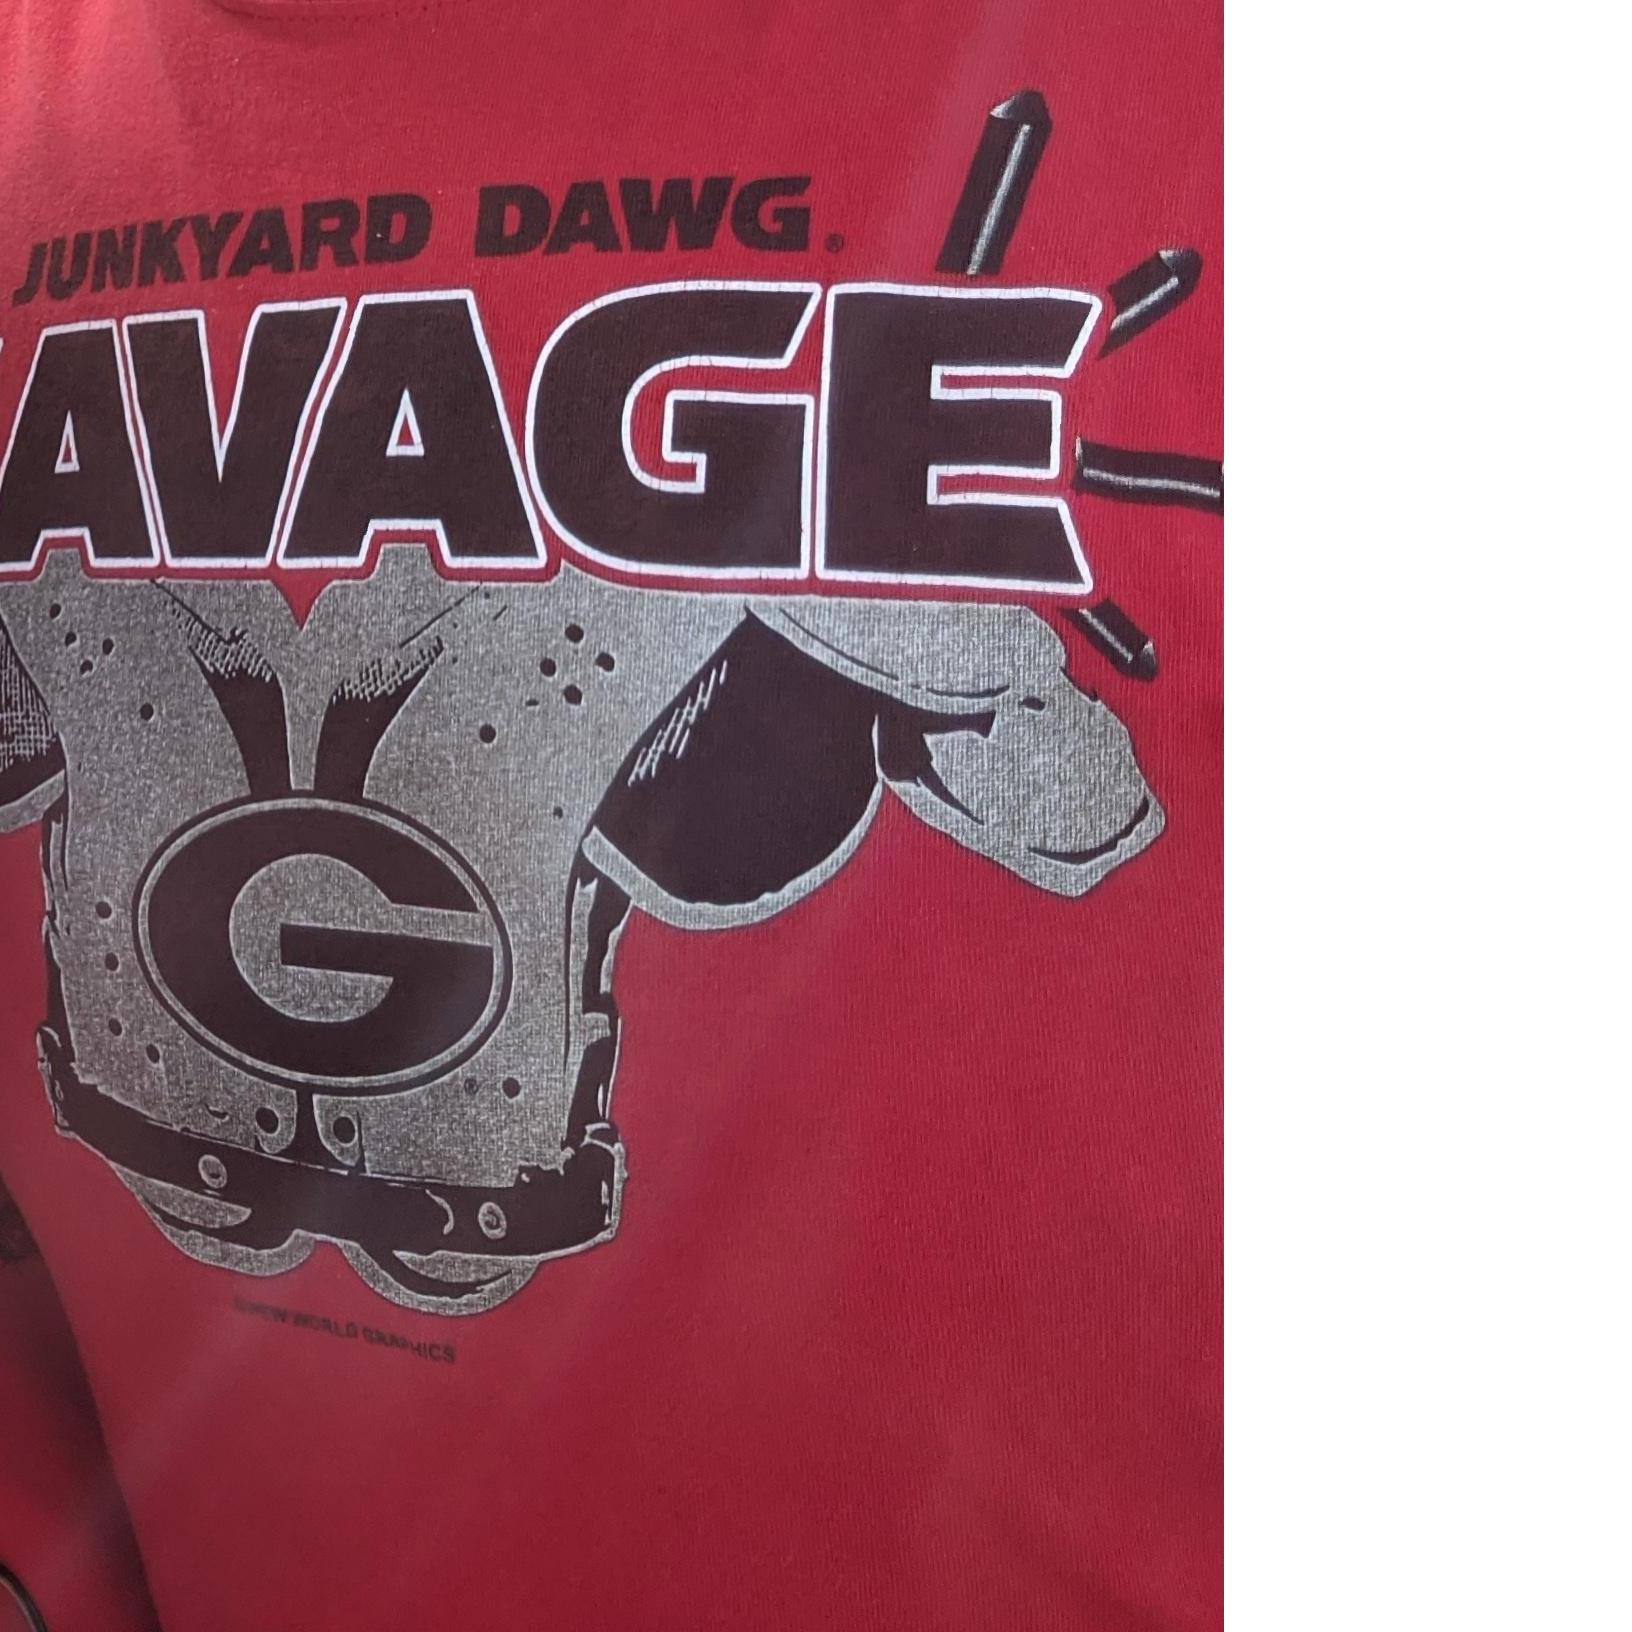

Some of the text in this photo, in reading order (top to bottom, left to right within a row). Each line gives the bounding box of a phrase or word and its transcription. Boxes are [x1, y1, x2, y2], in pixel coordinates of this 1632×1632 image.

[12, 176, 812, 307] JUNKYARD DAWG
[148, 804, 495, 1080] G
